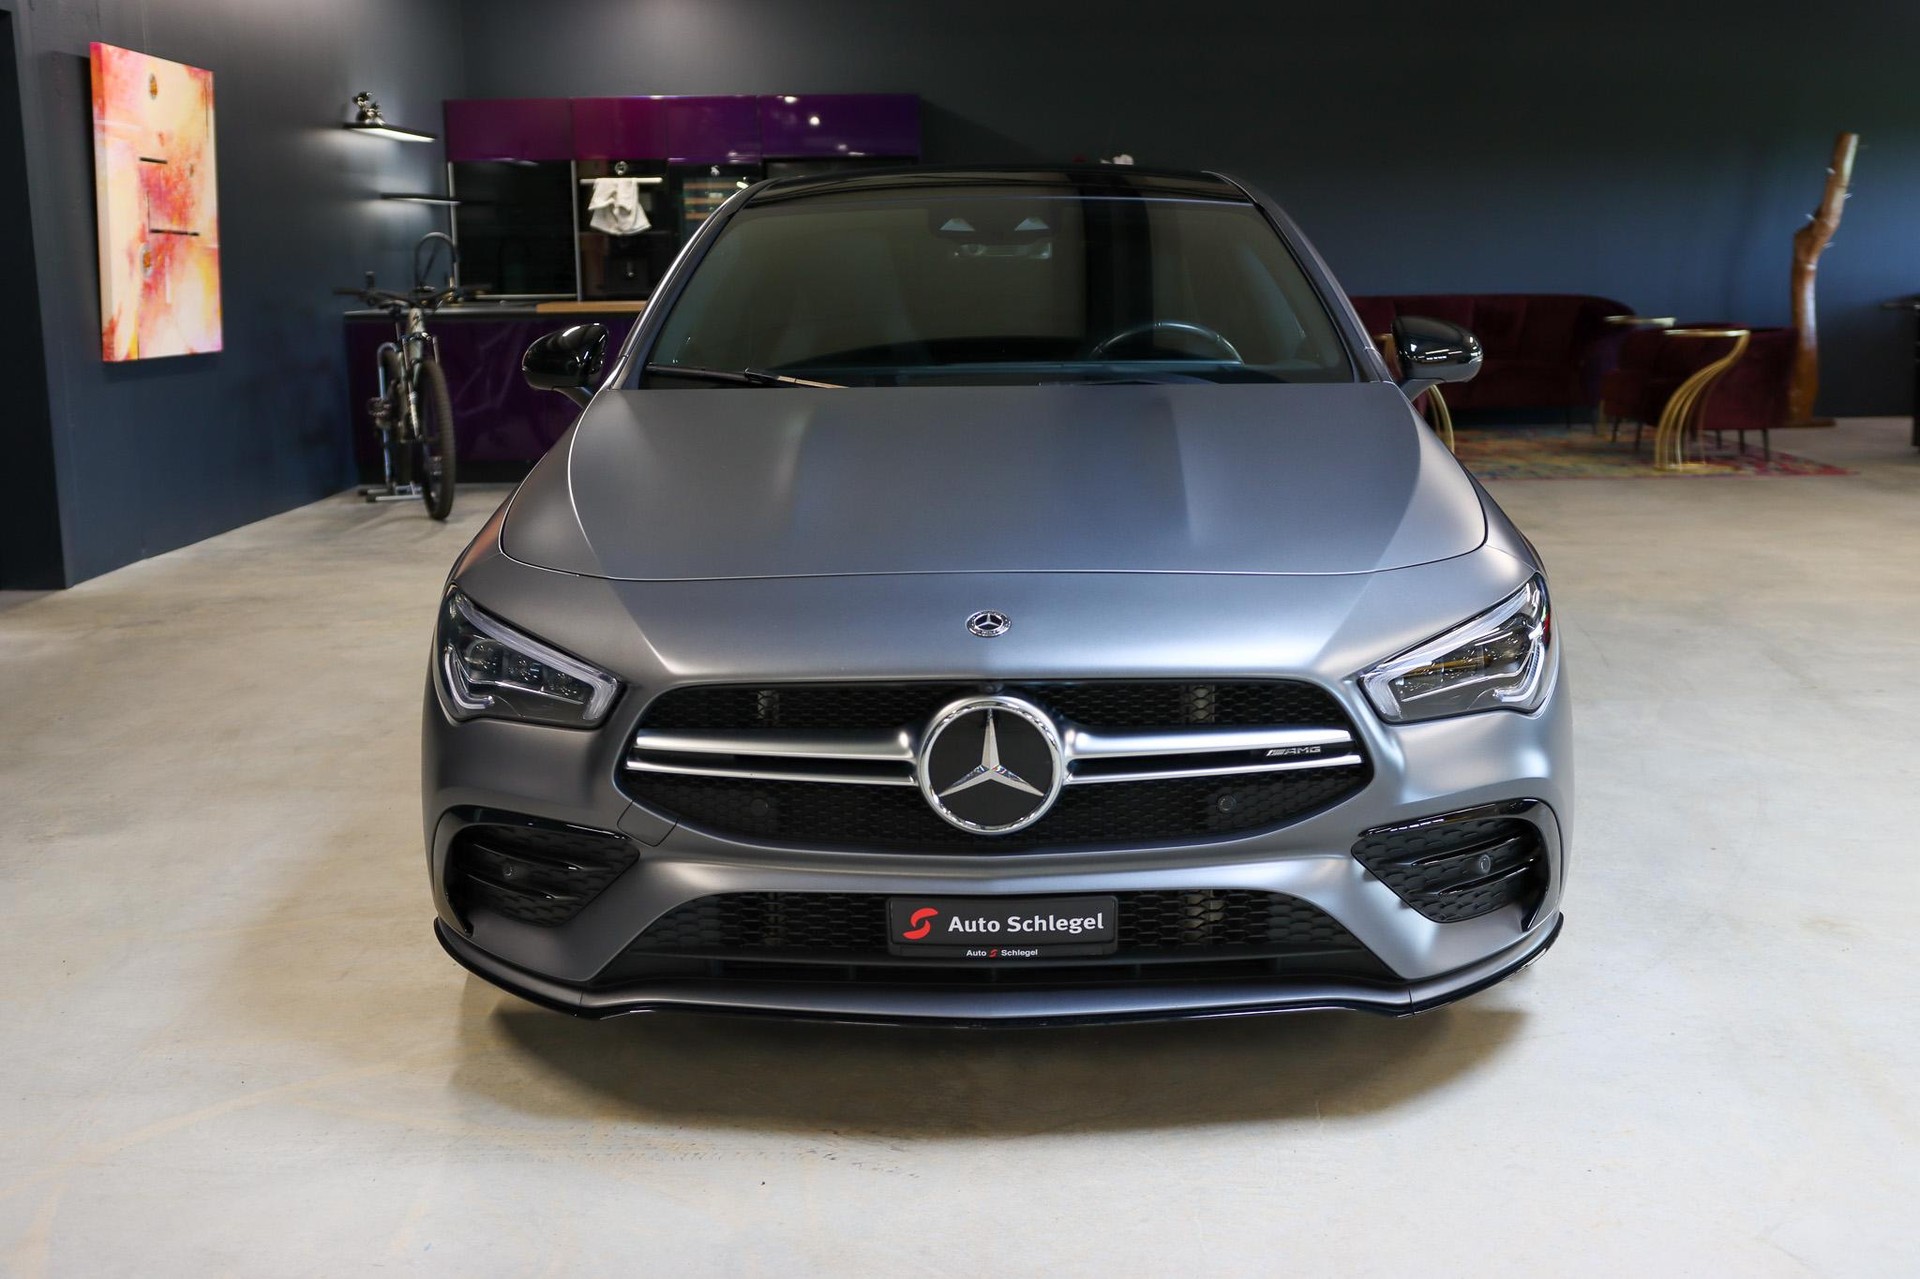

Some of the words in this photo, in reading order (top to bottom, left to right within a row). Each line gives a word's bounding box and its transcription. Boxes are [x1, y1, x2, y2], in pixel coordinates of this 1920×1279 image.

[1284, 746, 1321, 755] AMG
[948, 915, 1001, 933] Auto
[1007, 912, 1104, 934] Schlegel
[966, 949, 987, 957] Auto
[1001, 949, 1038, 958] Schlegel
